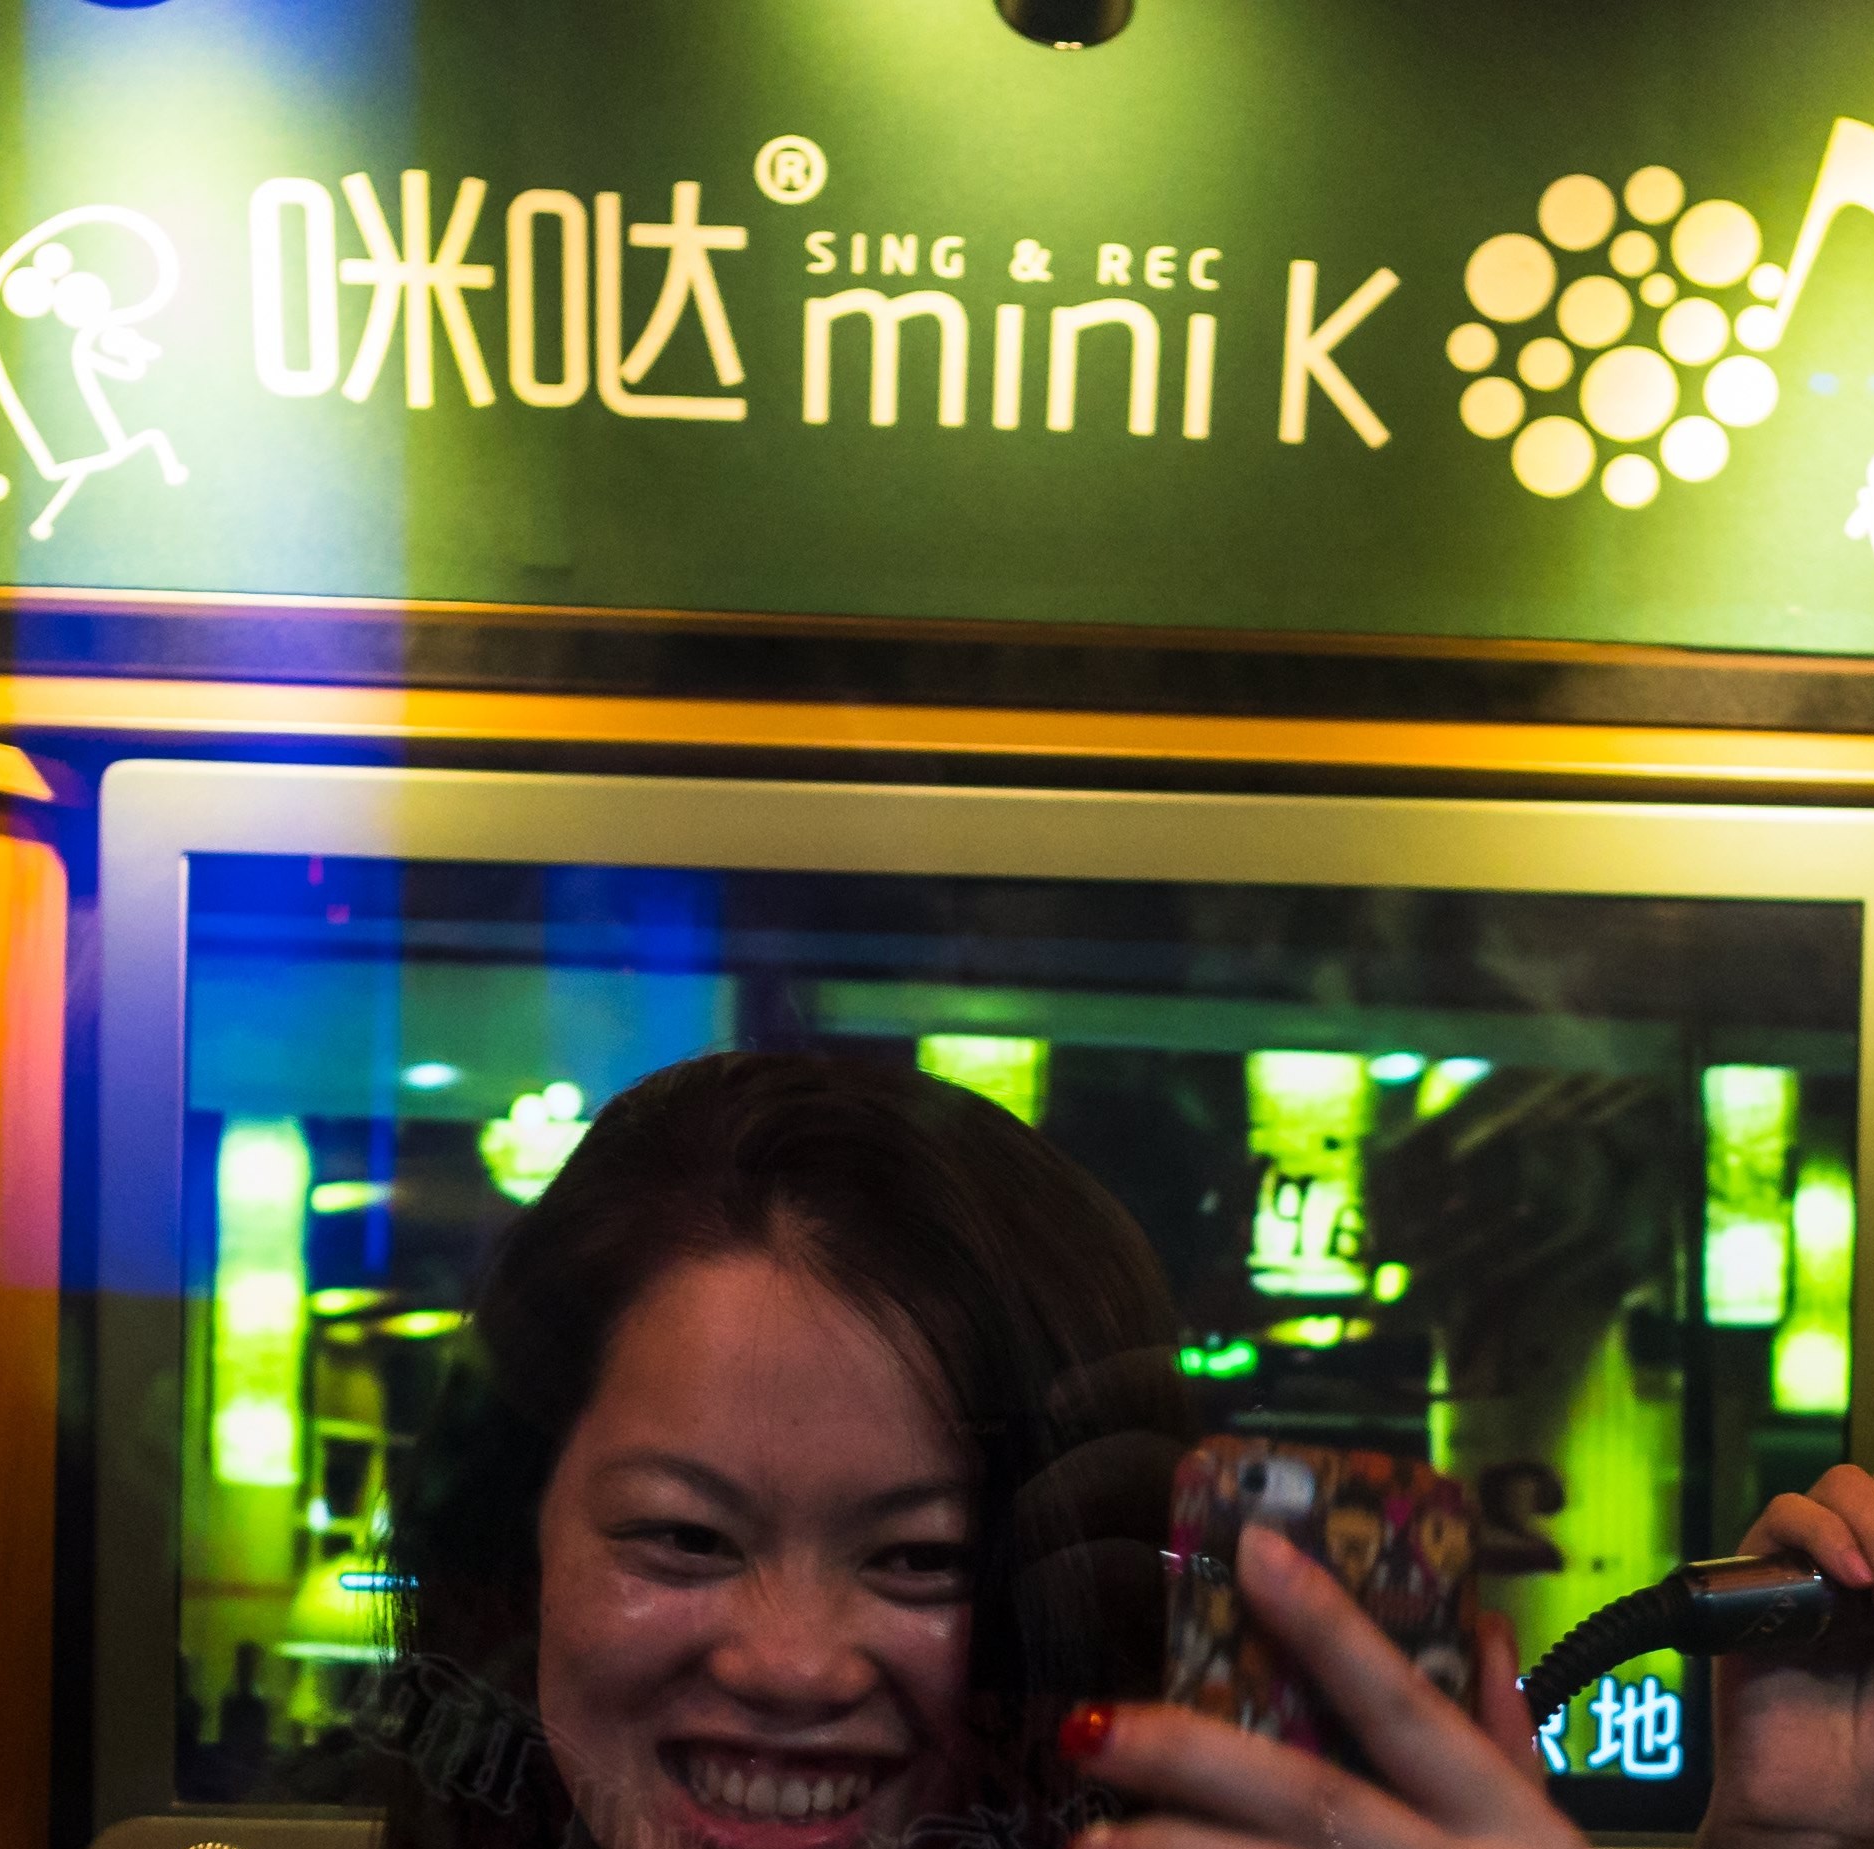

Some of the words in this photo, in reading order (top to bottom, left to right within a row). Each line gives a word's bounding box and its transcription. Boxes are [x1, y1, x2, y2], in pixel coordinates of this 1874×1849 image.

[249, 167, 749, 423] 咪哒
[801, 287, 1219, 440] mini
[1277, 259, 1402, 451] K
[804, 230, 968, 279] SING
[1008, 238, 1053, 283] &
[1096, 242, 1223, 290] REC
